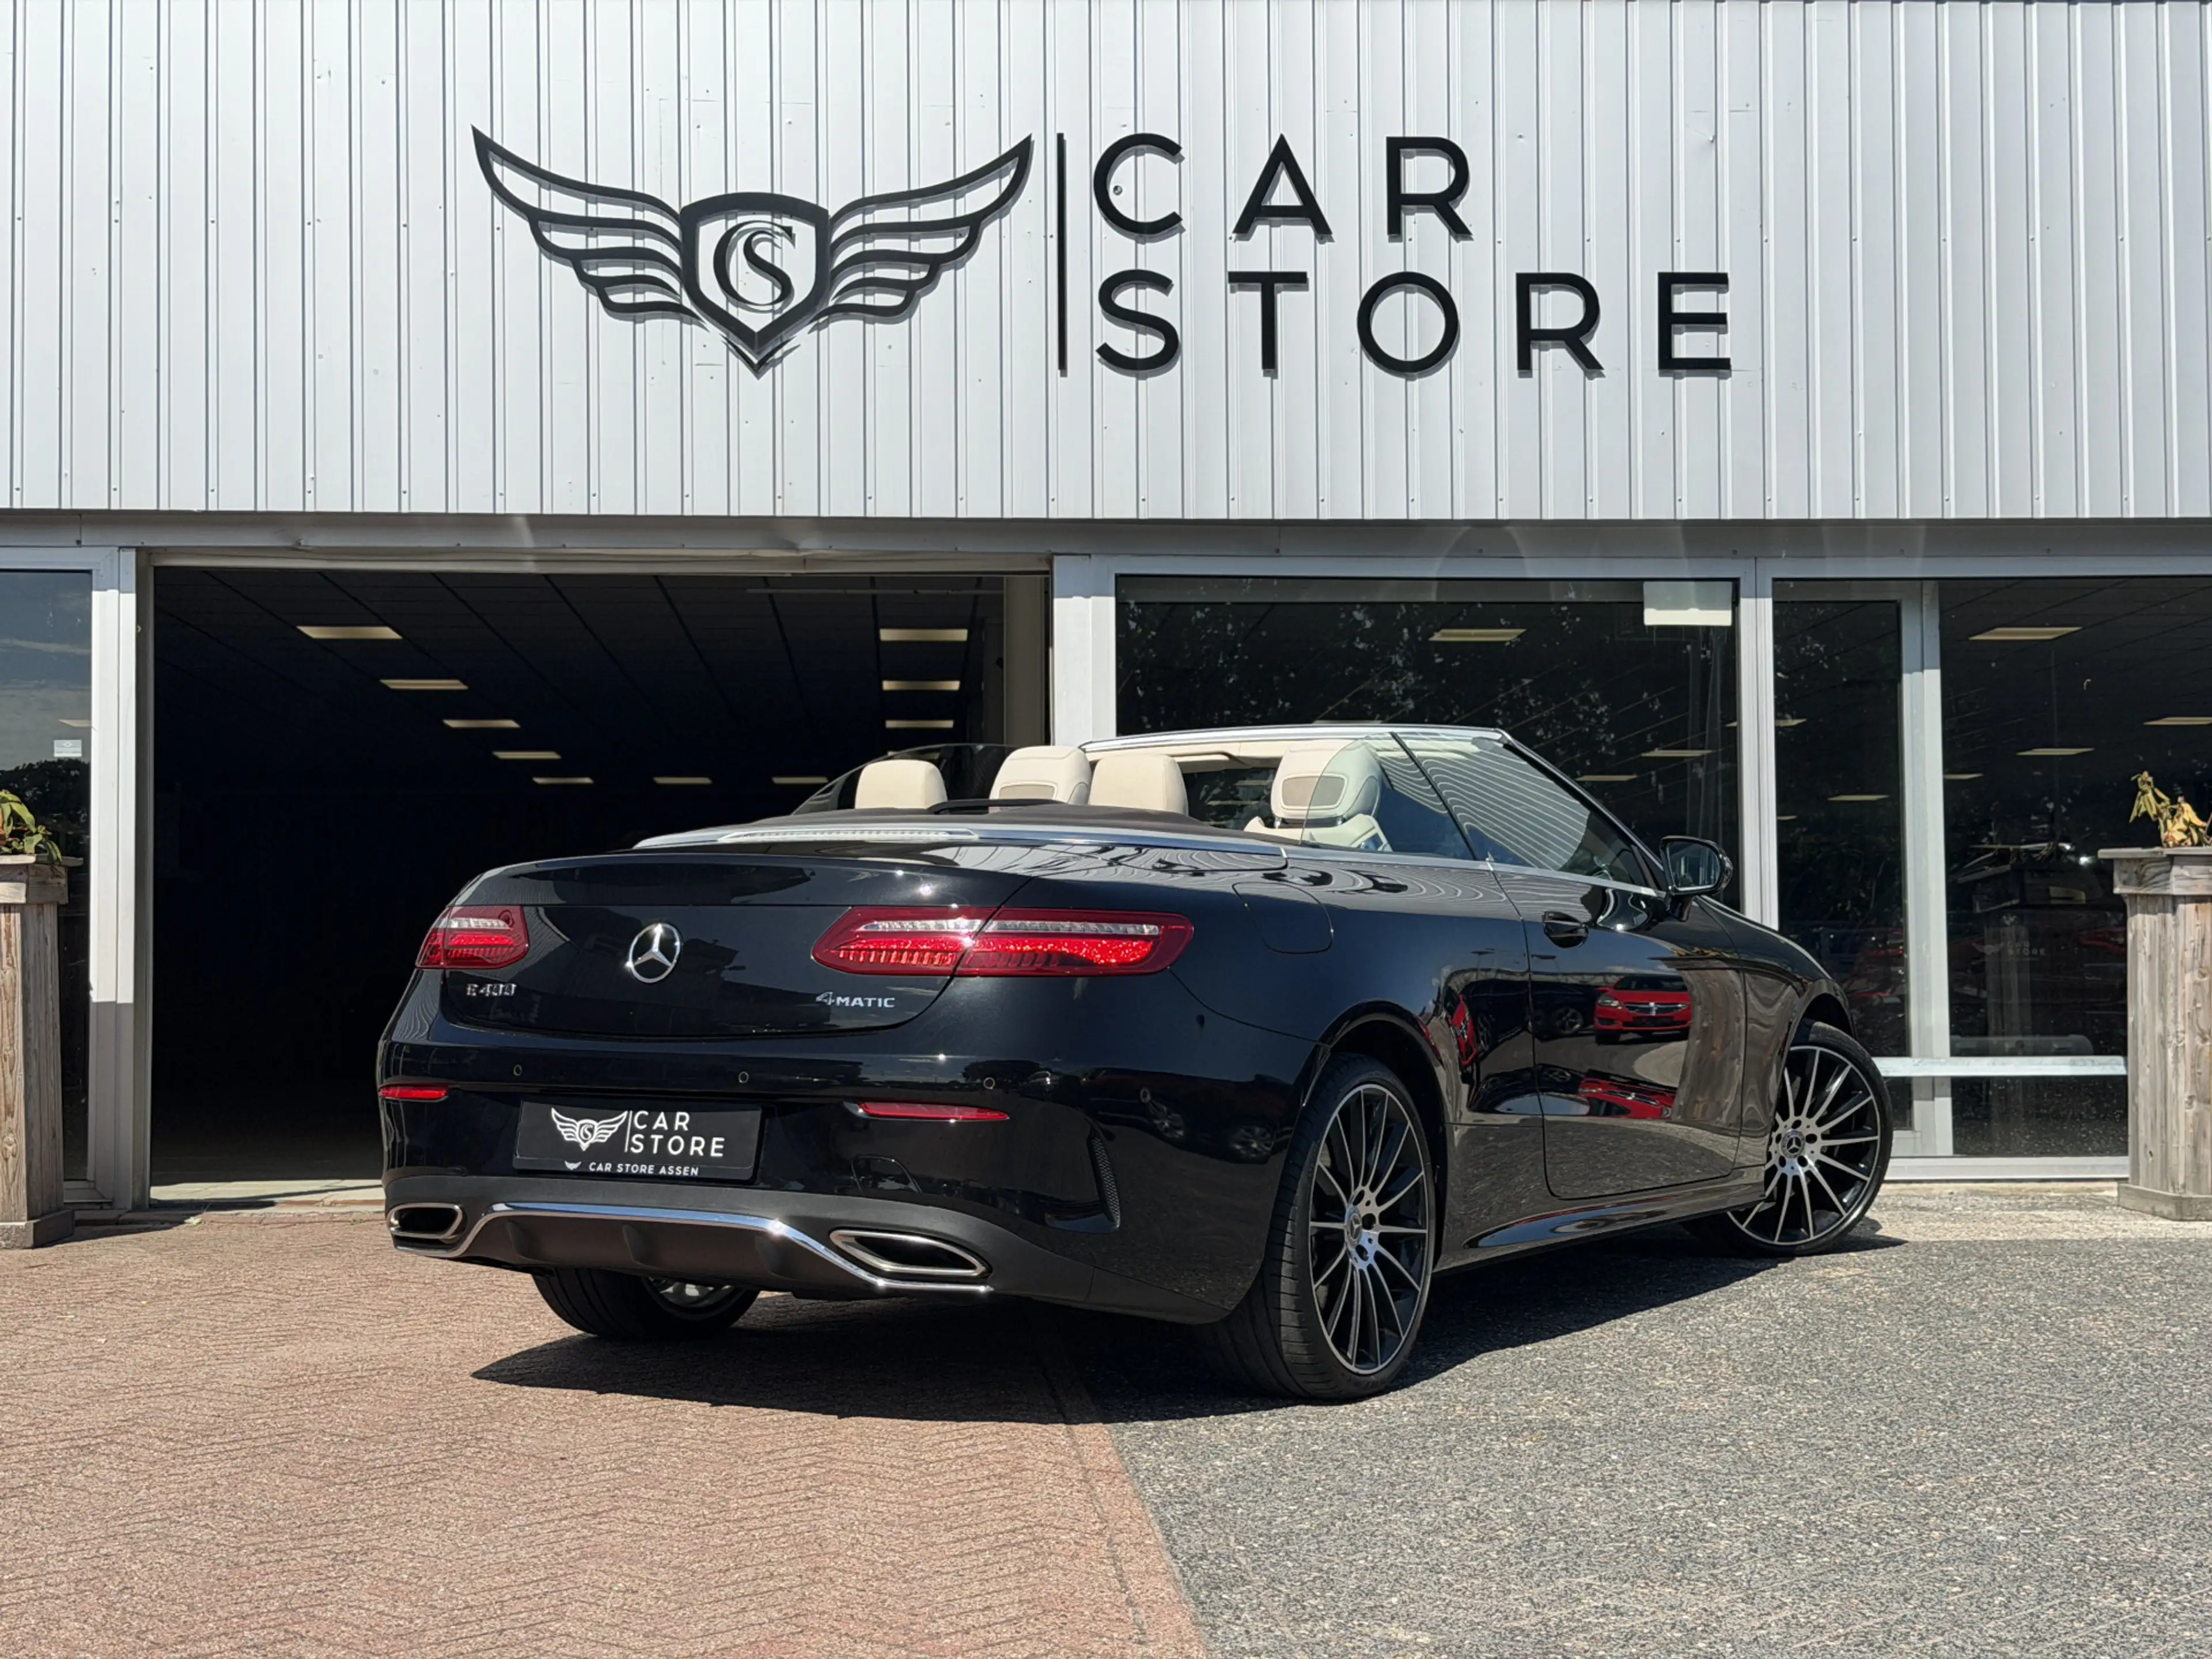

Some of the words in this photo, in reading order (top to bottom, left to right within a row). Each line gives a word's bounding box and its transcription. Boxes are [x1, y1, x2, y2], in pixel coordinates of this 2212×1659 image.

[1093, 132, 1472, 237] CAR
[1095, 269, 1732, 374] STORE
[815, 991, 895, 1007] 4MATIC
[634, 1110, 690, 1131] CAR
[630, 1133, 725, 1157] STORE
[589, 1162, 612, 1172] CAR
[616, 1163, 655, 1174] STORE
[658, 1165, 699, 1176] ASSEN
